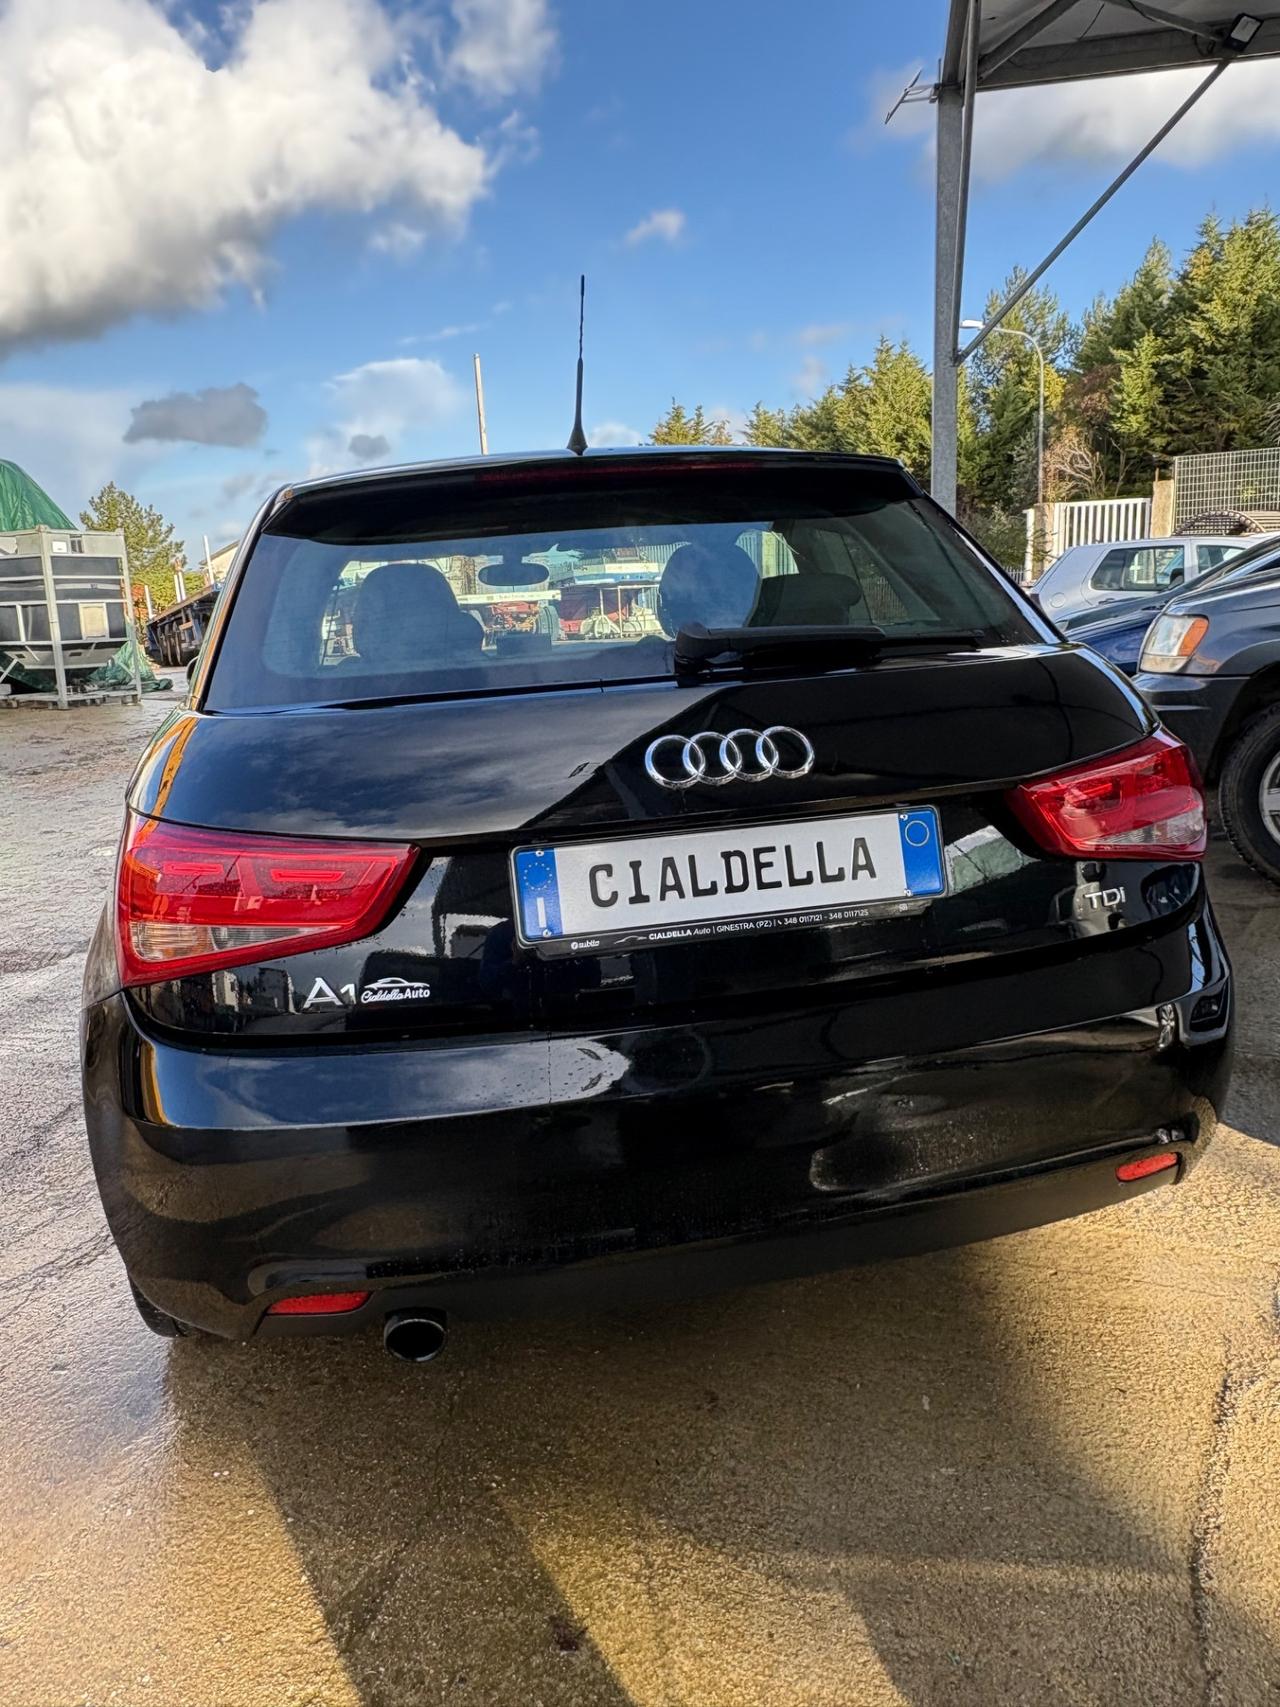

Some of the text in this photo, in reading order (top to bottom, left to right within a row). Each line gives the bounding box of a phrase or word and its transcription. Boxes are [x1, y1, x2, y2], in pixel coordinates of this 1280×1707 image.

[588, 837, 877, 907] CIALDELLA
[1084, 886, 1126, 909] TDI
[648, 929, 693, 940] CIALDELLA
[693, 928, 711, 936] Auto
[716, 922, 755, 933] GINESTRA
[756, 920, 773, 929] (PZ)
[783, 917, 798, 925] 348
[303, 977, 357, 1009] A1
